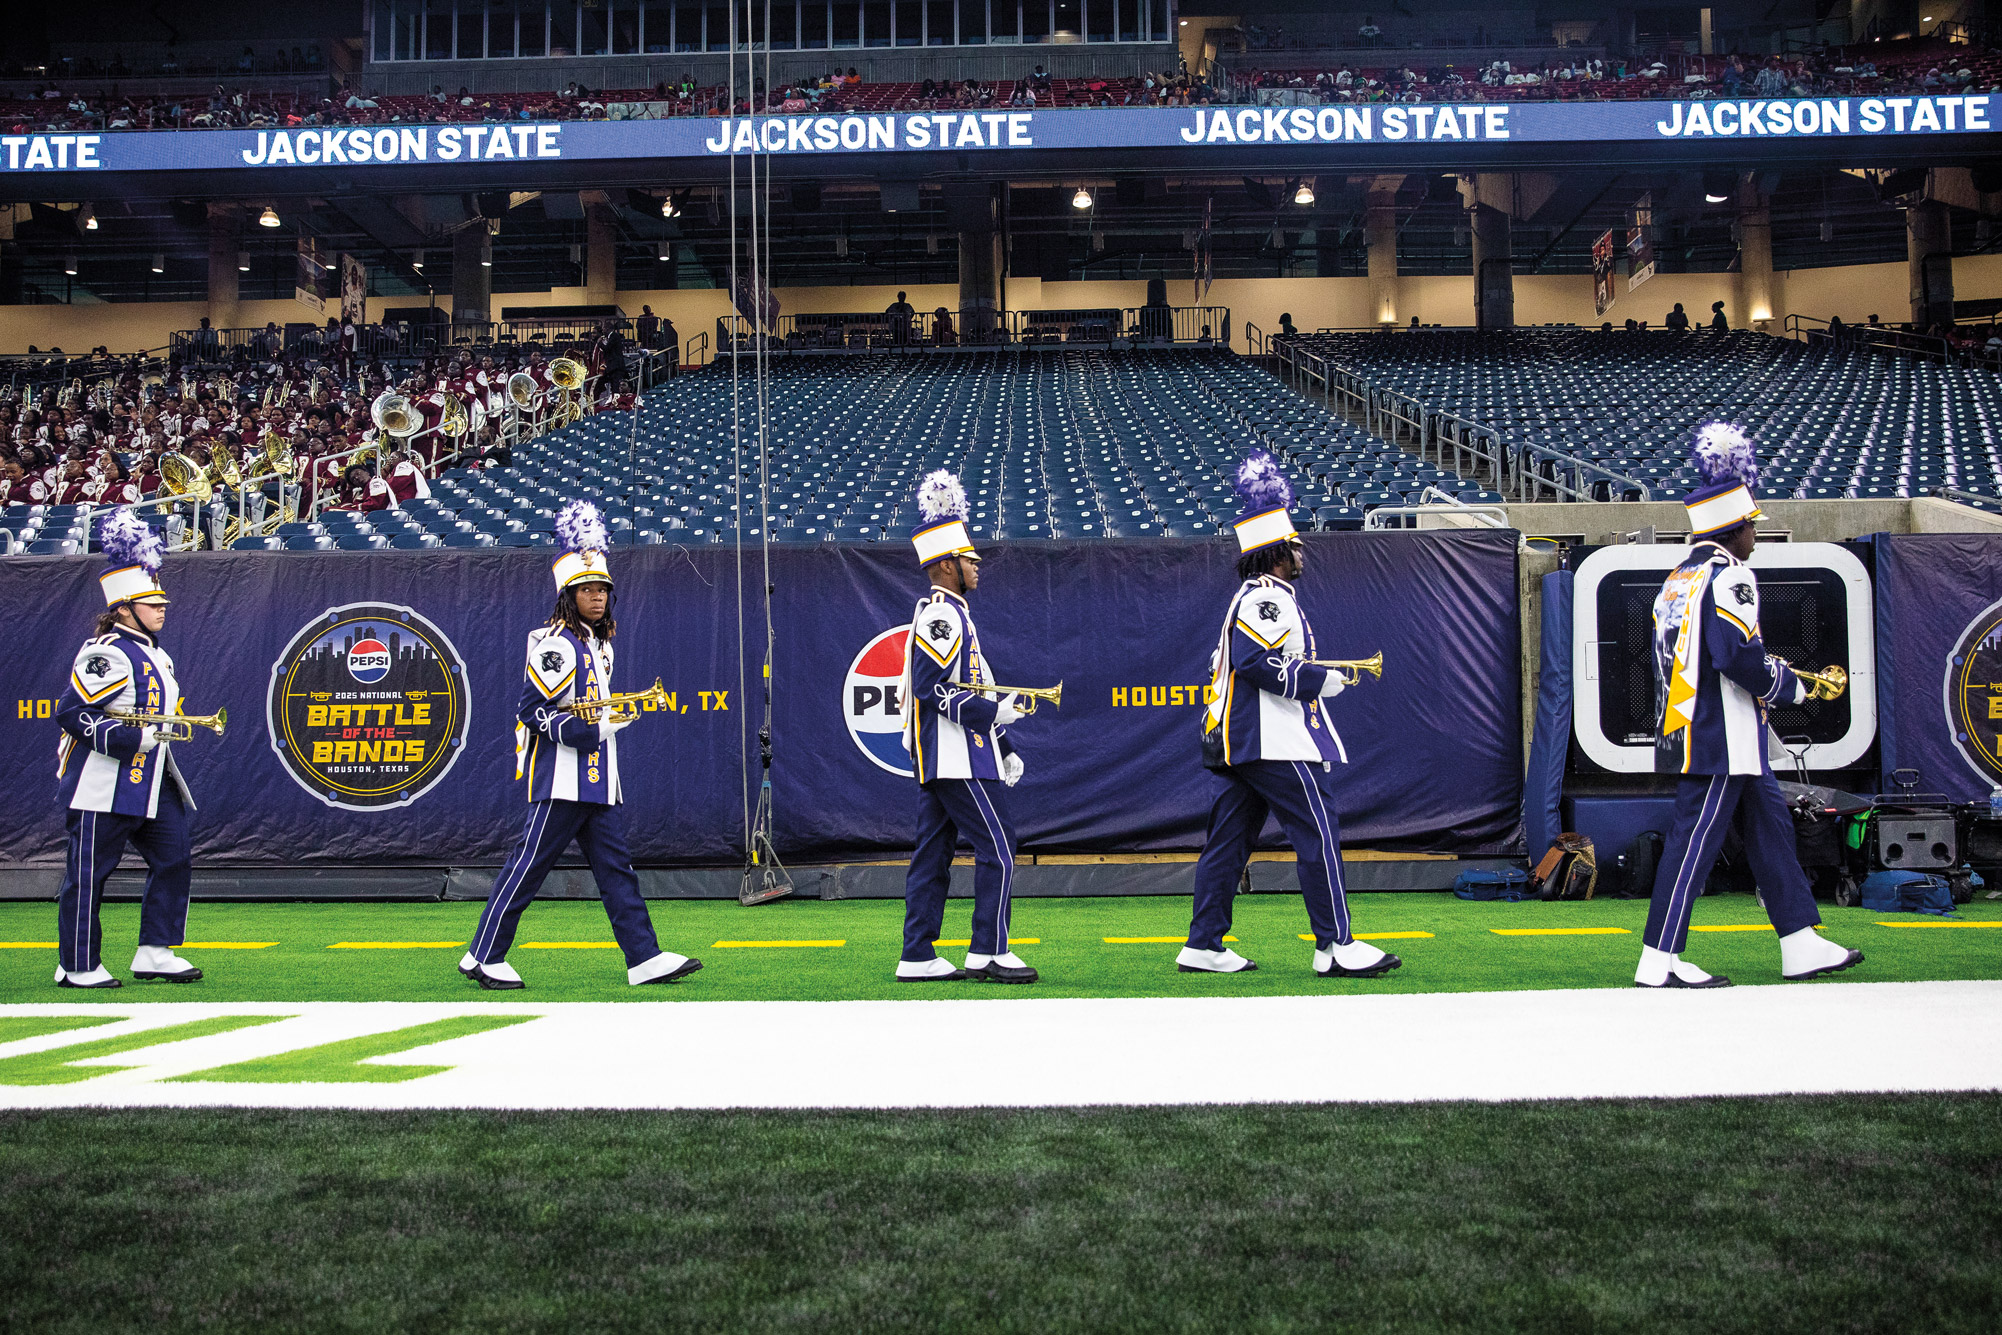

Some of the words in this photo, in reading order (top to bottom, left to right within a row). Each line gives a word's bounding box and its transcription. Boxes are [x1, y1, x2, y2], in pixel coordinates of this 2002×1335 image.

[1181, 107, 1372, 143] JACKSON
[1382, 106, 1510, 139] STATE
[1657, 99, 1850, 137] JACKSON
[1860, 96, 1990, 133] STATE
[706, 116, 895, 152] JACKSON
[905, 113, 1033, 148] STATE
[0, 136, 100, 169] TATE
[242, 128, 427, 165] JACKSON
[437, 125, 561, 160] STATE
[350, 656, 389, 666] PEPSI
[335, 691, 358, 700] 2025
[360, 691, 403, 699] NATIONAL
[698, 690, 729, 711] TX
[306, 703, 431, 727] BATTLE
[342, 728, 361, 739] OF
[363, 727, 395, 738] THE
[312, 739, 426, 763] BANDS
[327, 765, 376, 774] HOUSTON,
[379, 765, 410, 773] TEXAS
